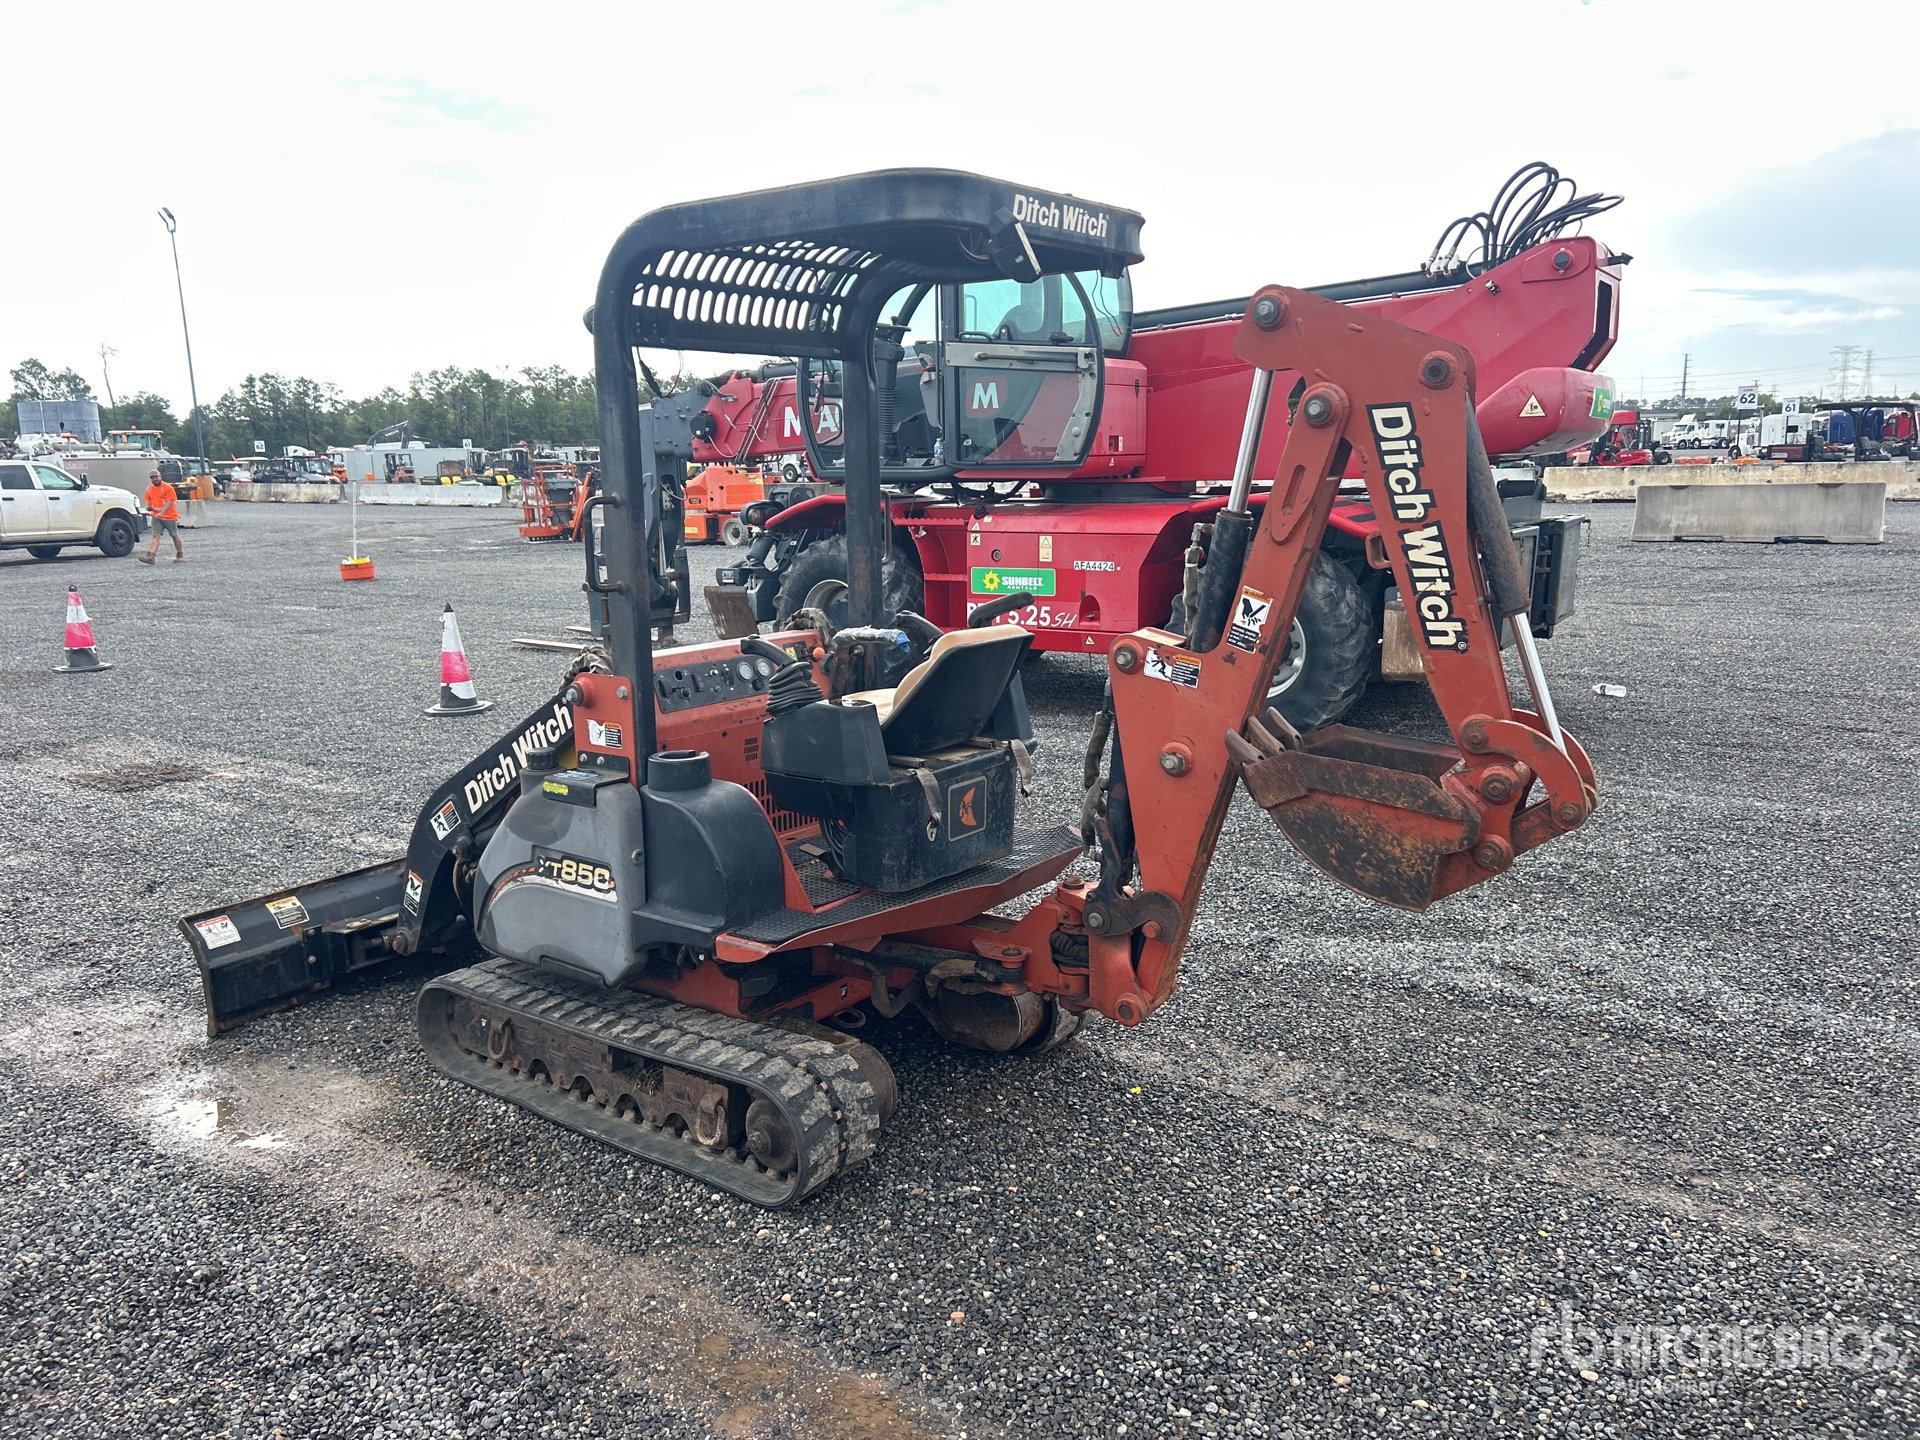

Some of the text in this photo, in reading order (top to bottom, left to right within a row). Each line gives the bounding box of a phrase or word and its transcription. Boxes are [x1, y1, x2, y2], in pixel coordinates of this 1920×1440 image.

[1012, 194, 1108, 238] Ditch Witch
[972, 382, 999, 410] M
[1740, 394, 1755, 404] 62
[1785, 404, 1796, 412] 61
[1371, 406, 1463, 646] Ditch Witch
[1074, 561, 1115, 571] AEA4424
[1001, 576, 1044, 587] SUNBELT
[1050, 612, 1077, 629] SH
[463, 703, 573, 815] Ditch Witch
